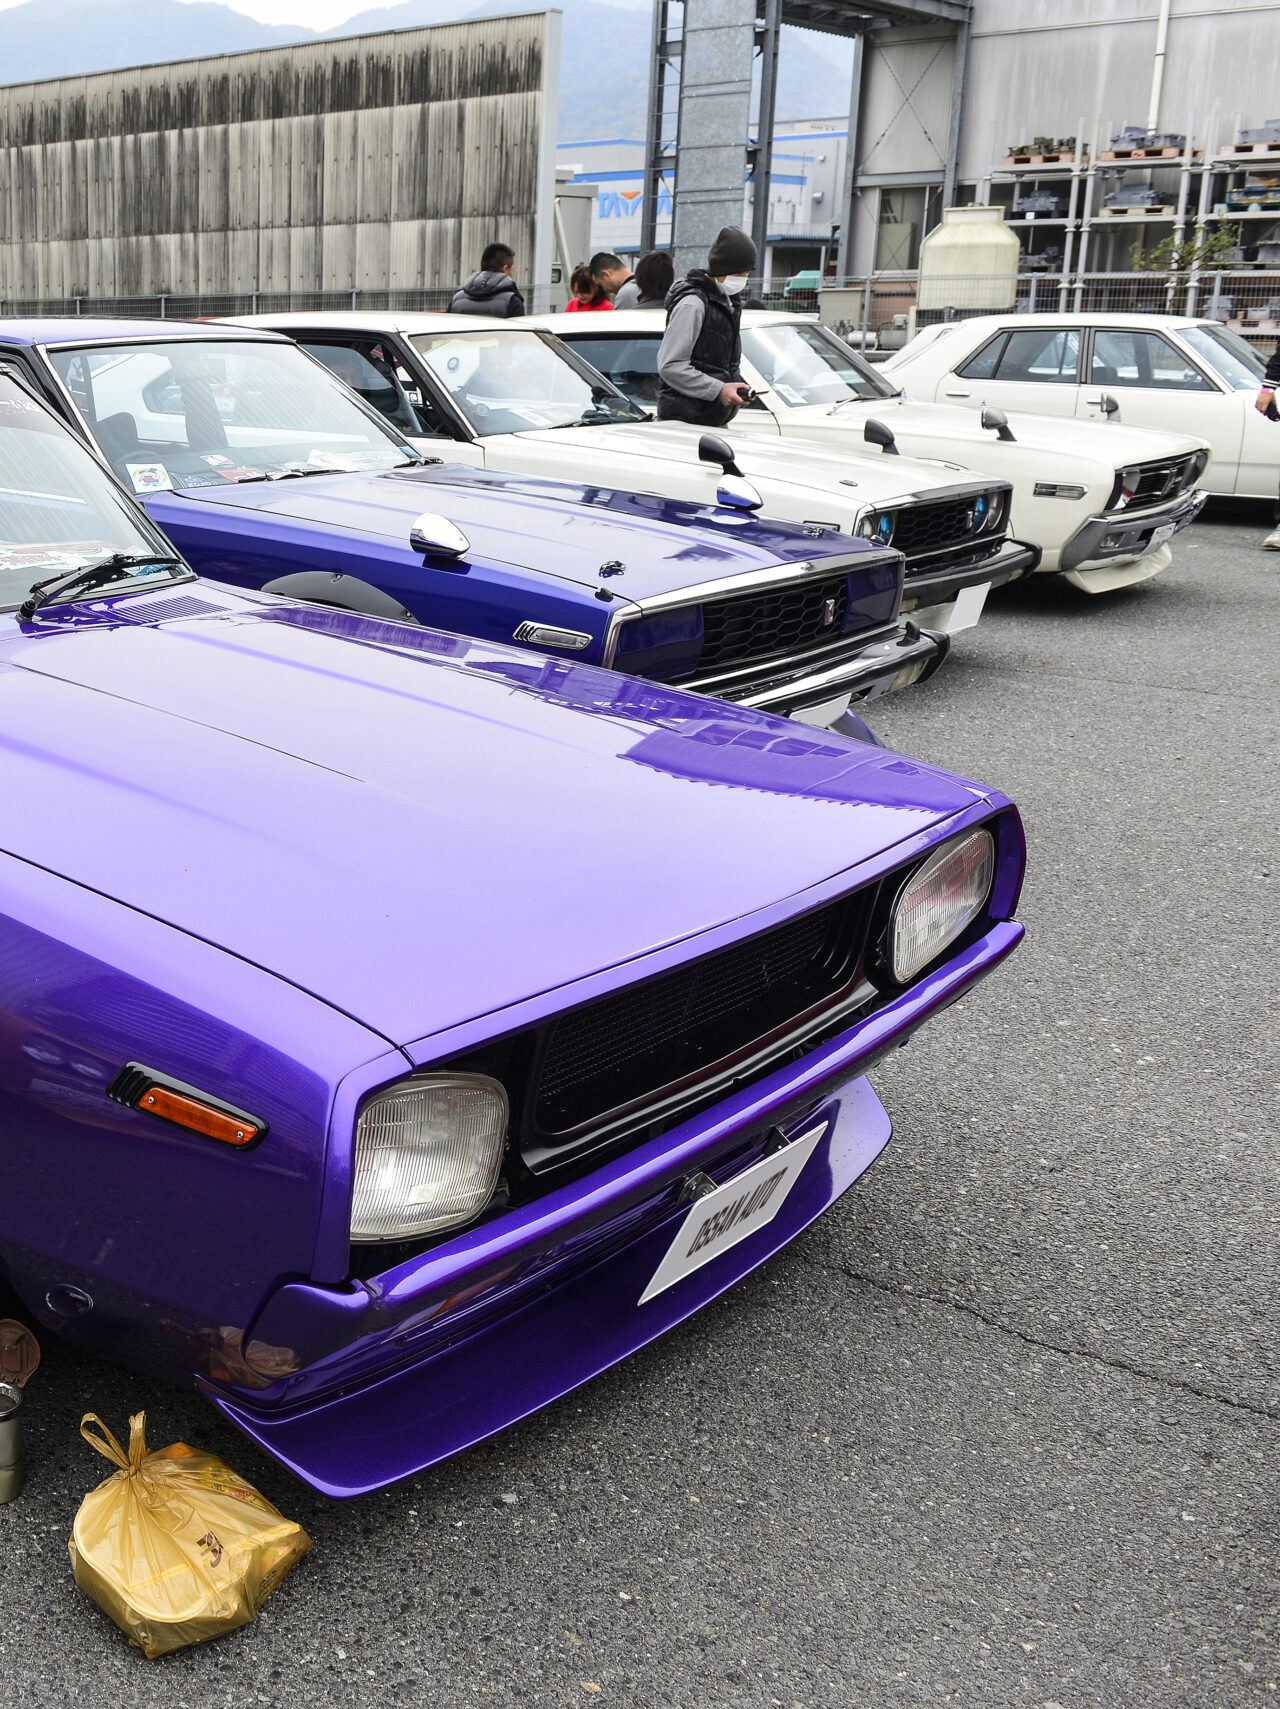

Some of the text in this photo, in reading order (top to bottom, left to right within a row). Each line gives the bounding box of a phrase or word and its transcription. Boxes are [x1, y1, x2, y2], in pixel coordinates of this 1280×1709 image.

[597, 189, 673, 217] TAYA
[685, 1165, 789, 1259] OSSAN AUTO
